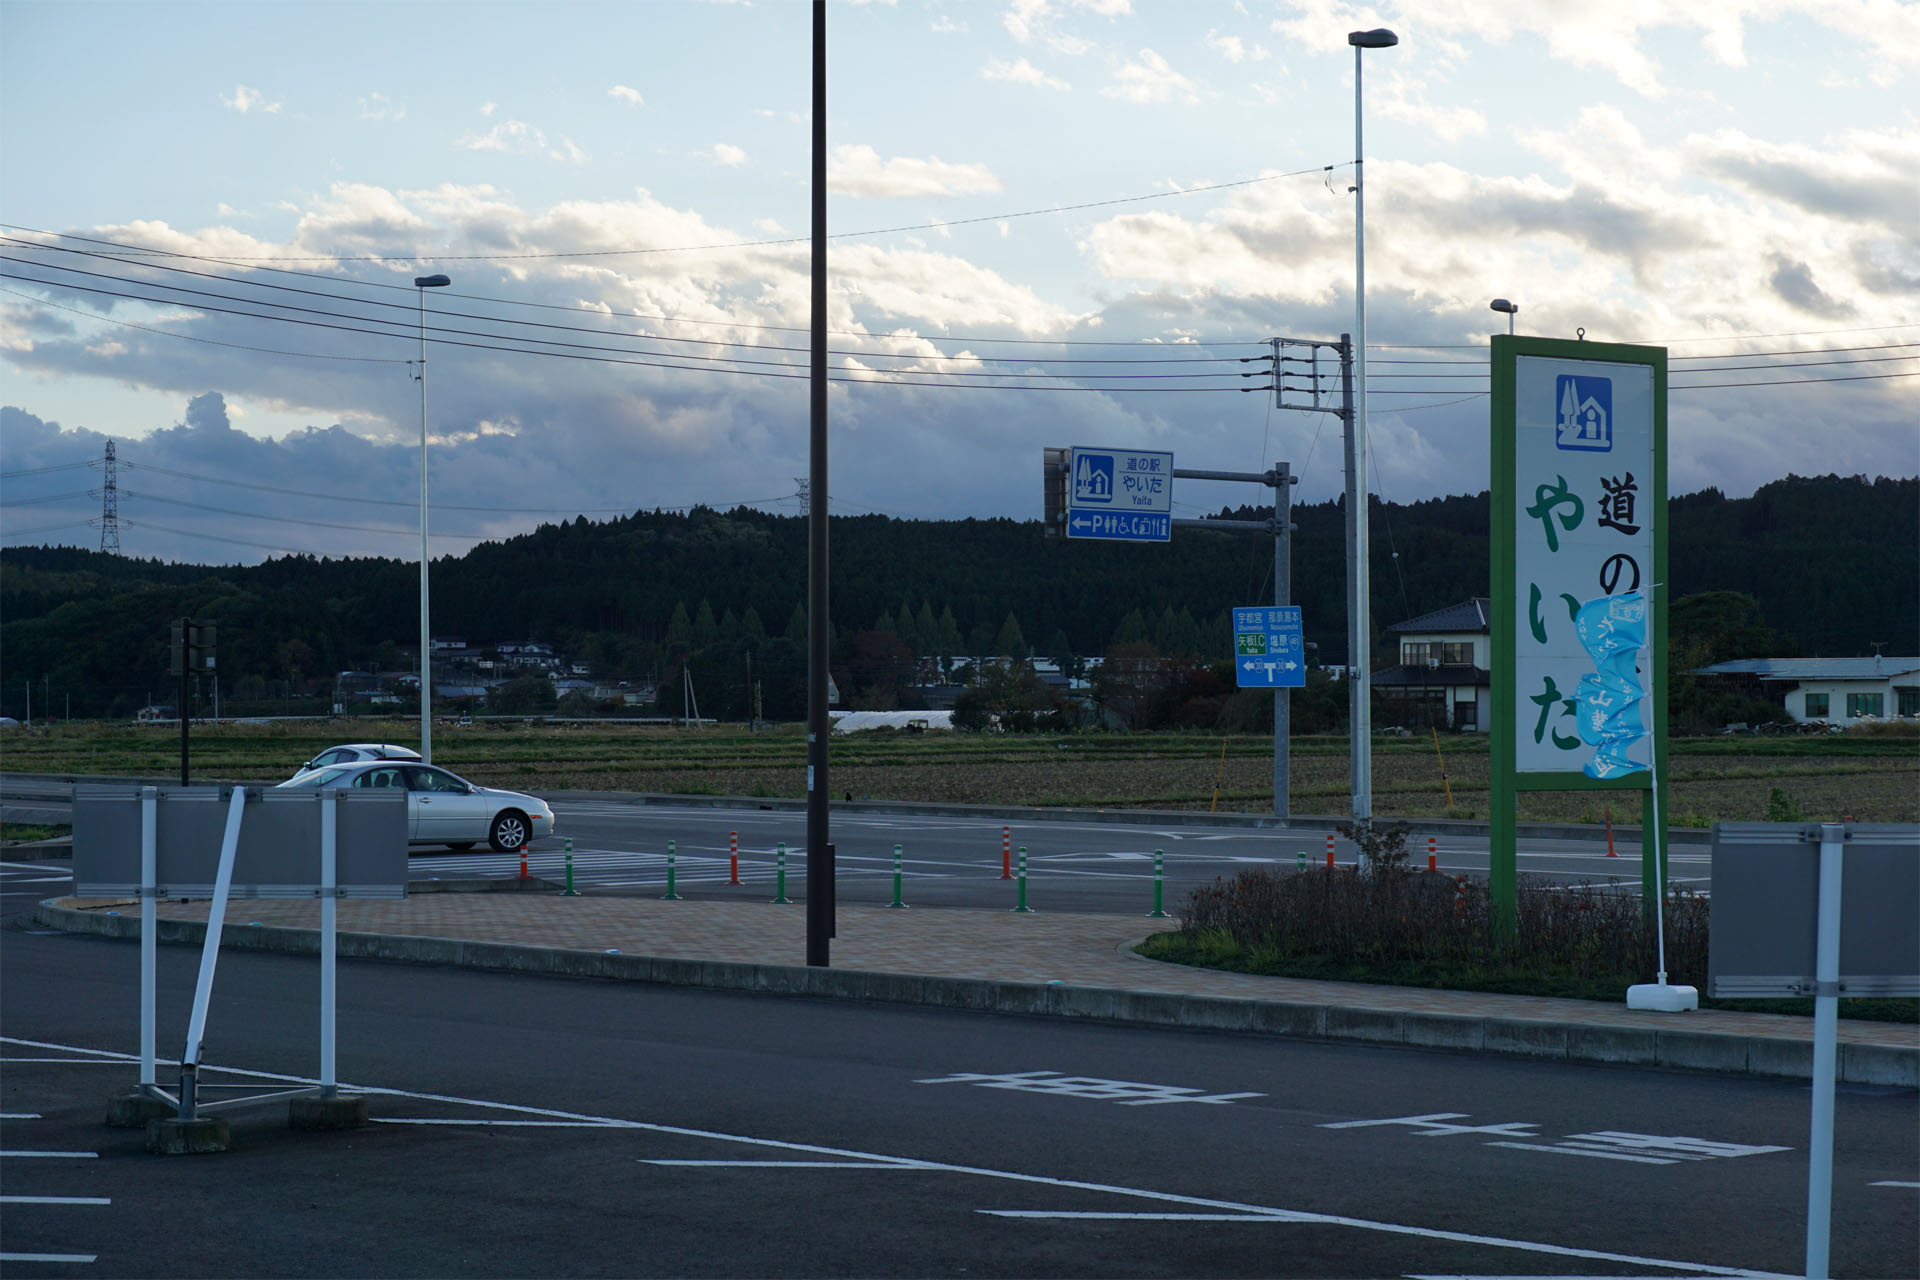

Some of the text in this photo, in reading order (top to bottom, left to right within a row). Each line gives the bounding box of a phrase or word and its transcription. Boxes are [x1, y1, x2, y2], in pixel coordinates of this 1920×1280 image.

[1127, 457, 1160, 472] 道の駅
[1123, 475, 1163, 494] やいた
[1132, 495, 1152, 506] Yaita
[1598, 471, 1641, 674] 道の
[1238, 612, 1263, 624] 宇都宮
[1526, 474, 1584, 750] やいた
